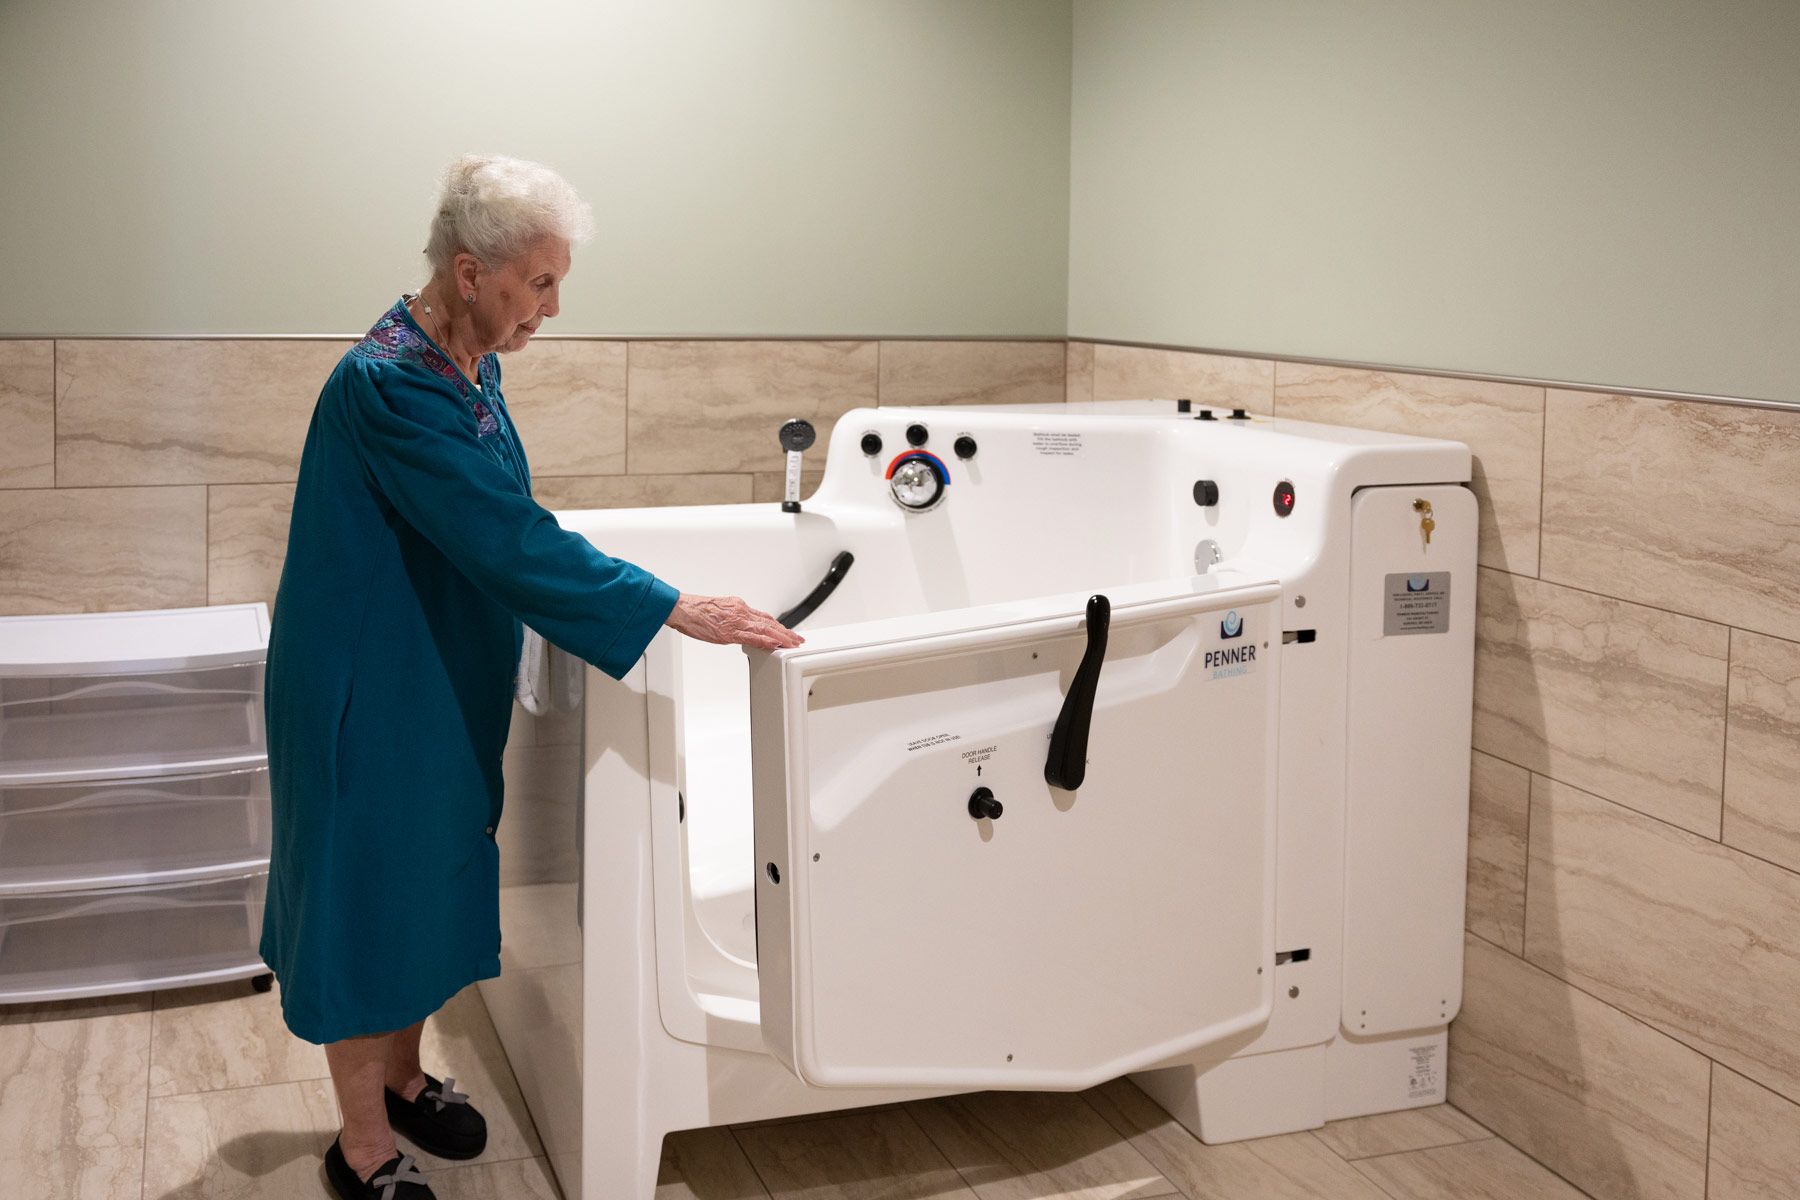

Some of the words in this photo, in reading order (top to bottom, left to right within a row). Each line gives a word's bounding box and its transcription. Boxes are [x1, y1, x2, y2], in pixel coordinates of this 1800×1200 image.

[1204, 645, 1256, 669] PENNER
[961, 750, 977, 759] DOOR
[977, 746, 998, 755] HANDLE
[968, 754, 991, 764] RELEASE
